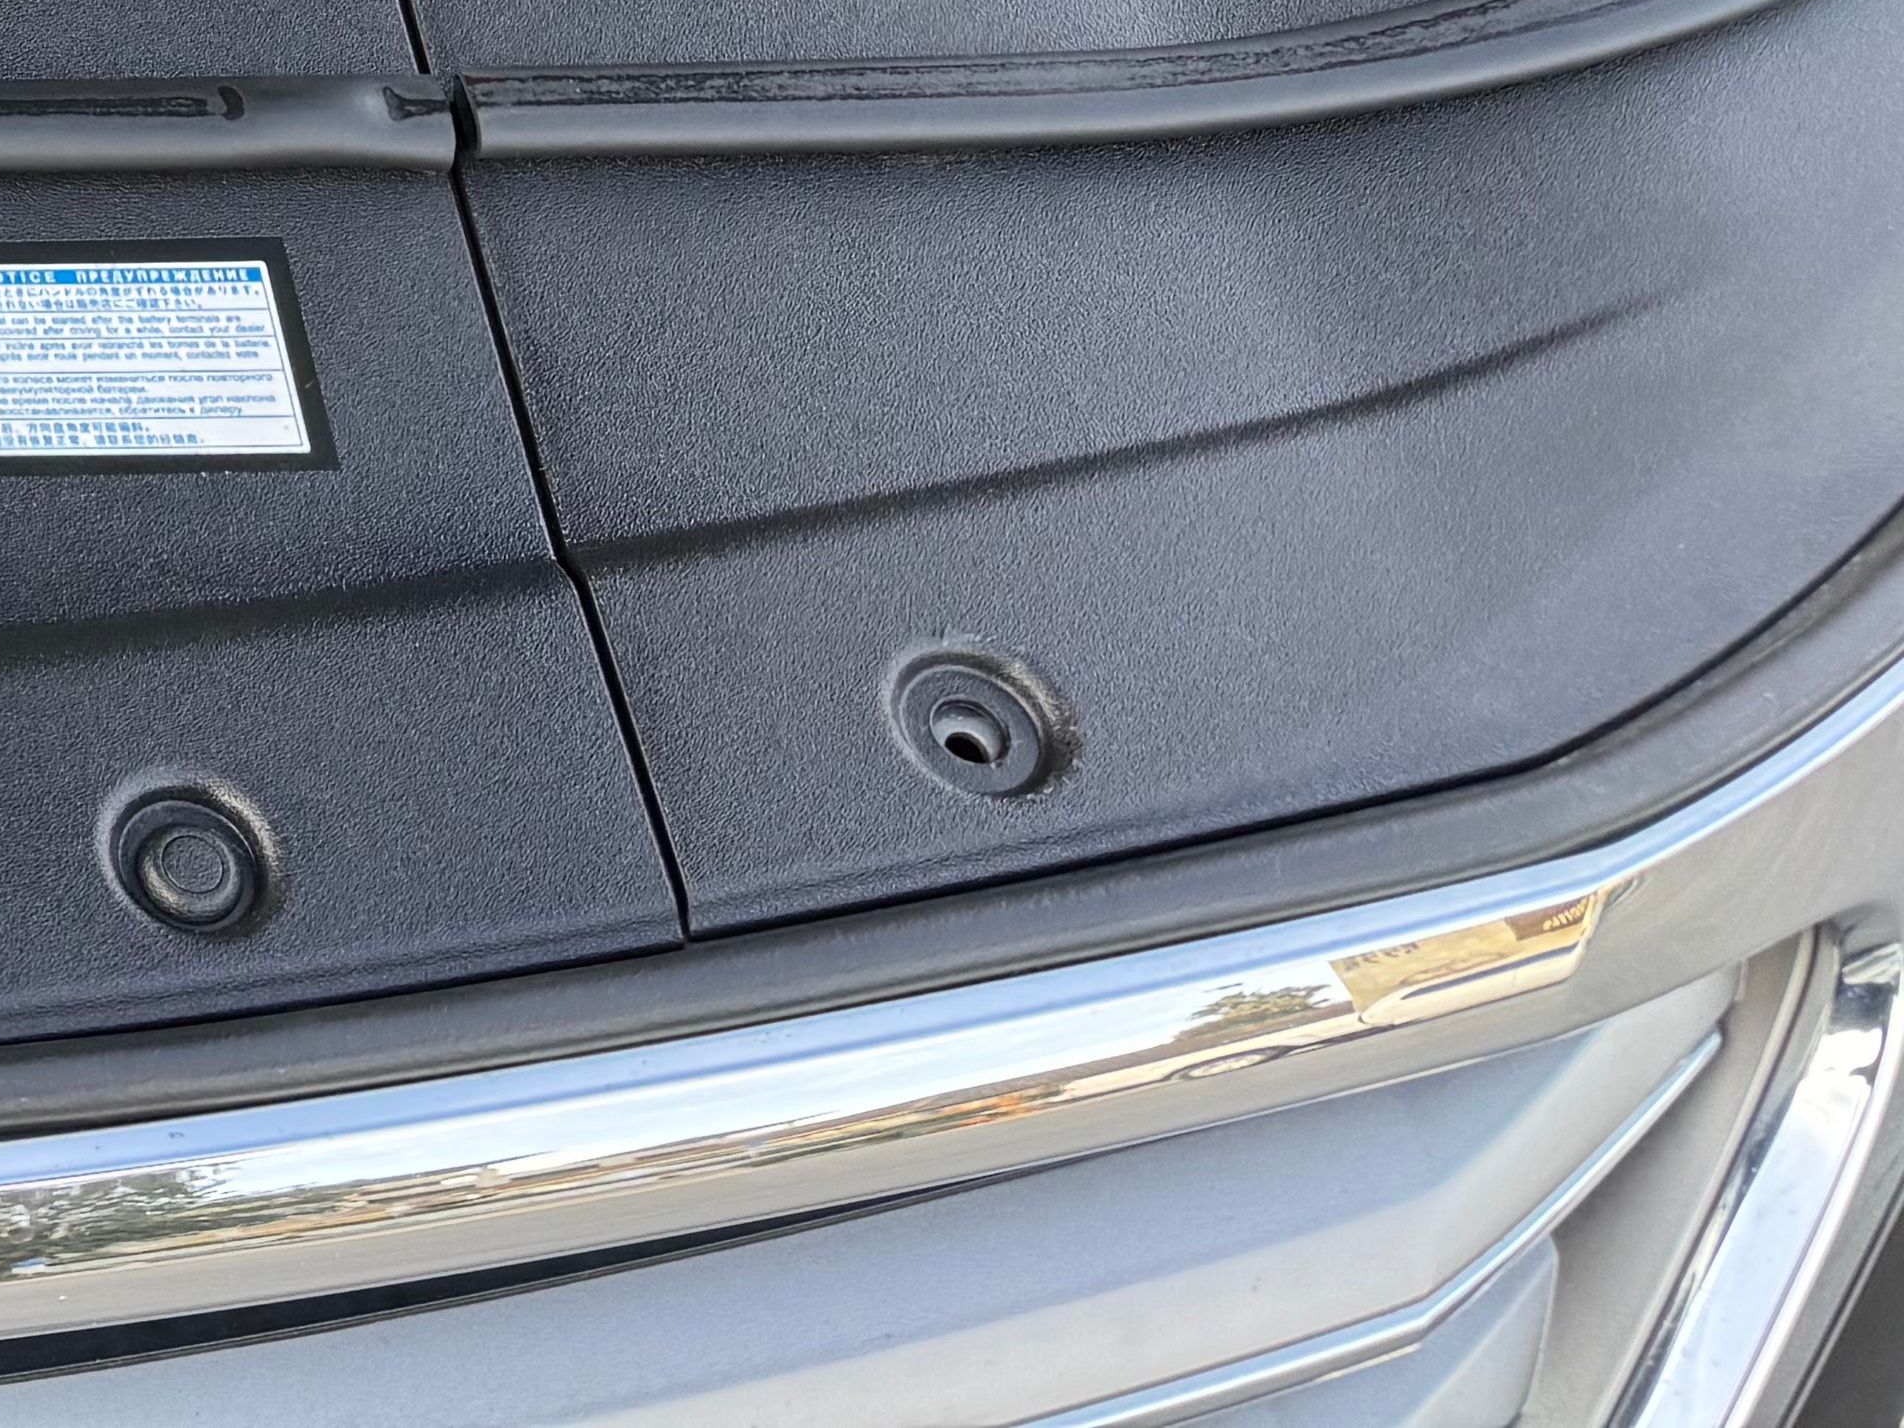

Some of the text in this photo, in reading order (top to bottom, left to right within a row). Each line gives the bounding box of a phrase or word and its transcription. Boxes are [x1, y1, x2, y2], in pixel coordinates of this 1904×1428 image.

[75, 268, 249, 285] ПРЕДУПРЕЖДЕНИЕ
[11, 316, 29, 324] can
[33, 316, 47, 324] be
[117, 316, 134, 324] the
[168, 325, 204, 333] contact
[208, 324, 230, 335] your
